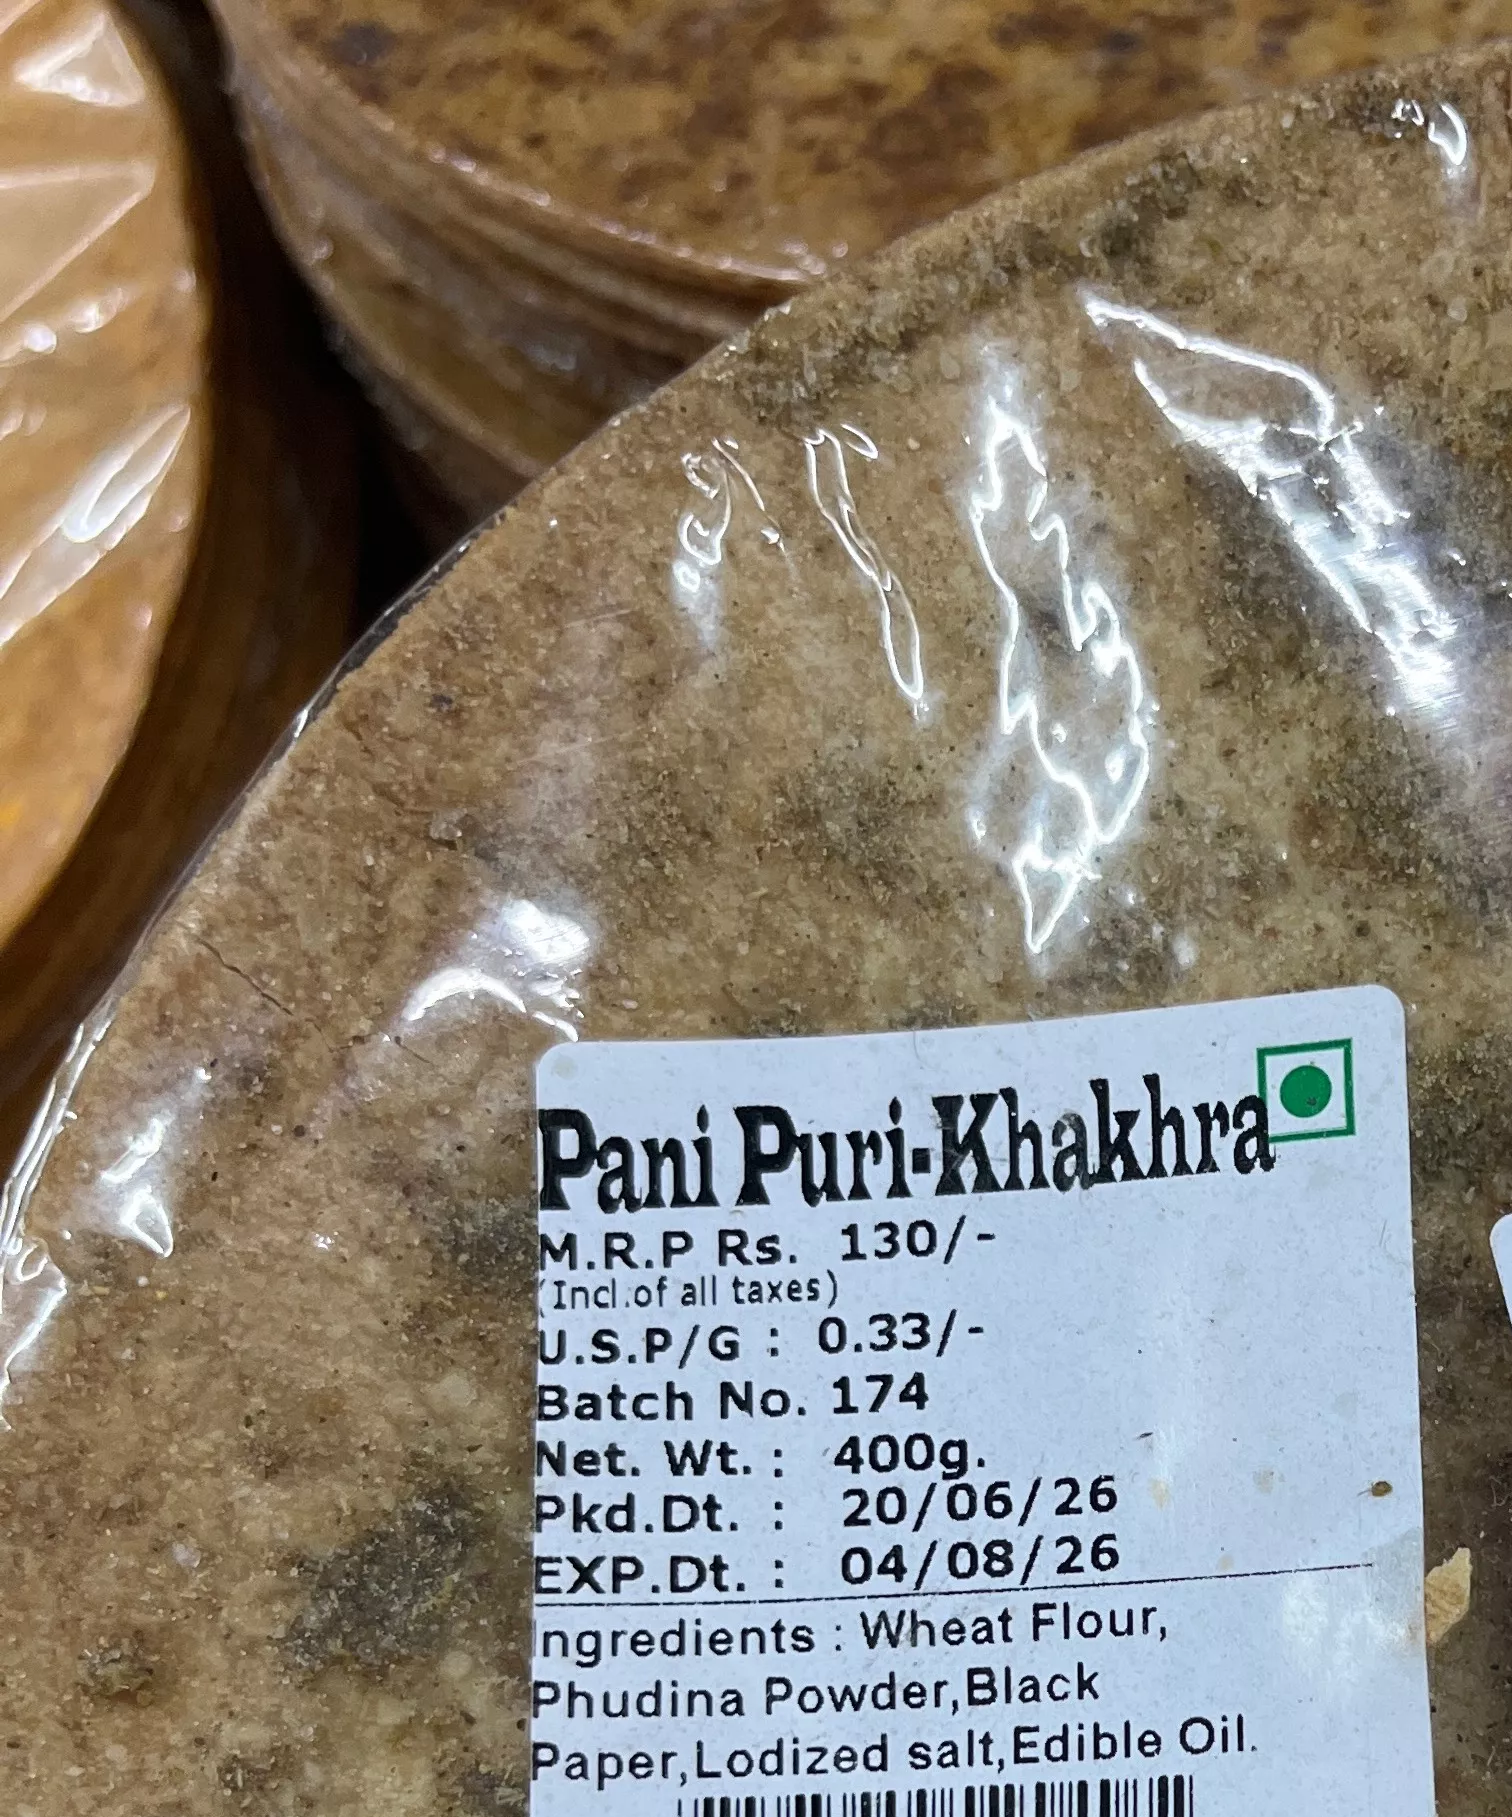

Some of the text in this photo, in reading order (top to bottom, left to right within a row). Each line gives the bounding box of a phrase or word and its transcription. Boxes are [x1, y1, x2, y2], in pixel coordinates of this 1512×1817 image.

[538, 1073, 1276, 1214] Pani Puri-Khakhra
[539, 1215, 996, 1271] M.R.P Rs. 130/-
[681, 1274, 717, 1307] all
[732, 1270, 838, 1309] taxes)
[540, 1309, 985, 1369] U.S.P/G : 0.33/-
[537, 1372, 930, 1422] Batch No. 174
[536, 1433, 986, 1481] Net. Wt. : 400g.
[535, 1475, 1118, 1534] Pkd.Dt. : 20/06/26
[535, 1533, 1120, 1595] EXP.Dt. : 04/08/26
[835, 1624, 843, 1652] :
[859, 1607, 1013, 1651] Wheat
[1032, 1602, 1168, 1643] Flour,
[533, 1661, 1100, 1719] Phudina Powder,Black
[531, 1713, 1258, 1791] Paper,Lodized salt,Edible Oil.
